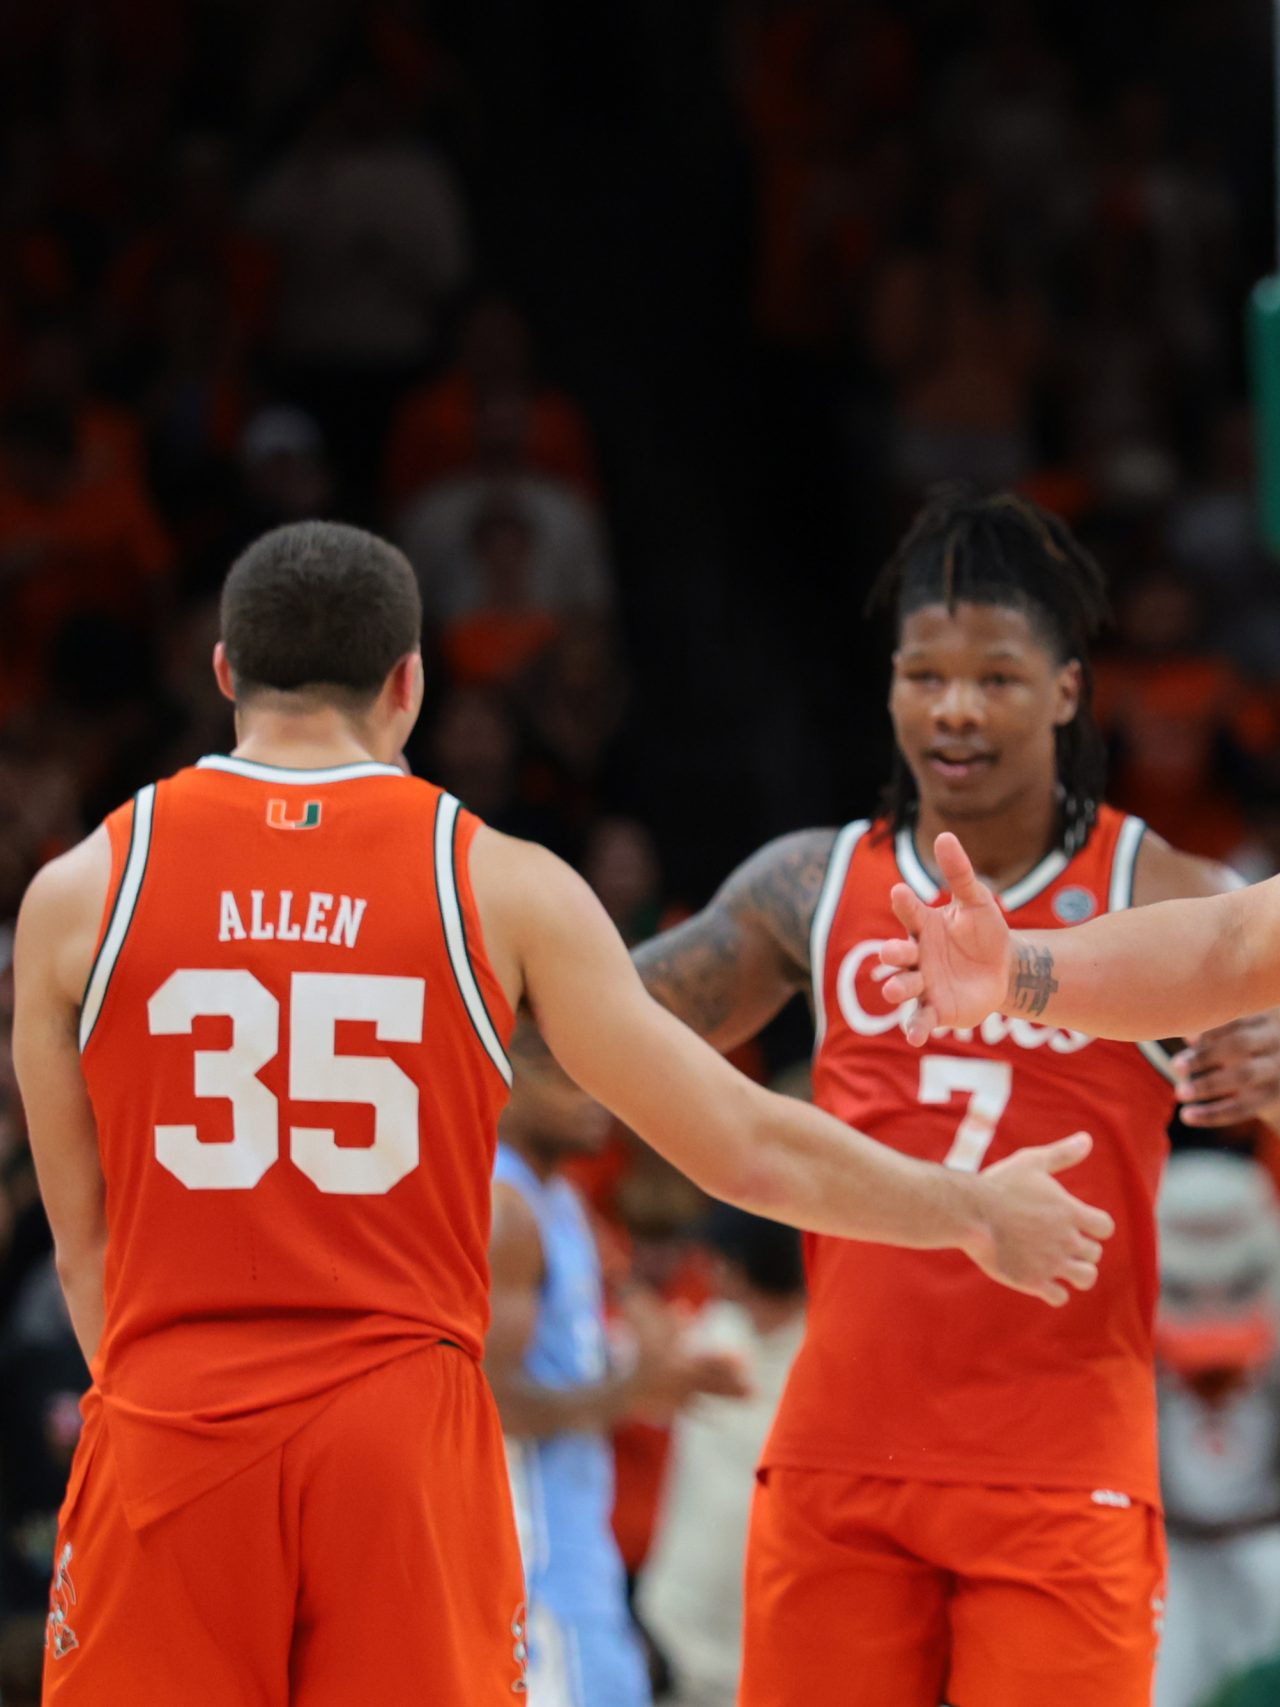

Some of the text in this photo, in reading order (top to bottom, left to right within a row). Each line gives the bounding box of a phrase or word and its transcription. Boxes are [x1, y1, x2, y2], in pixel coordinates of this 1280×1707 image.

[218, 890, 367, 949] ALLEN
[147, 968, 426, 1195] 35
[917, 1054, 1013, 1174] 7
